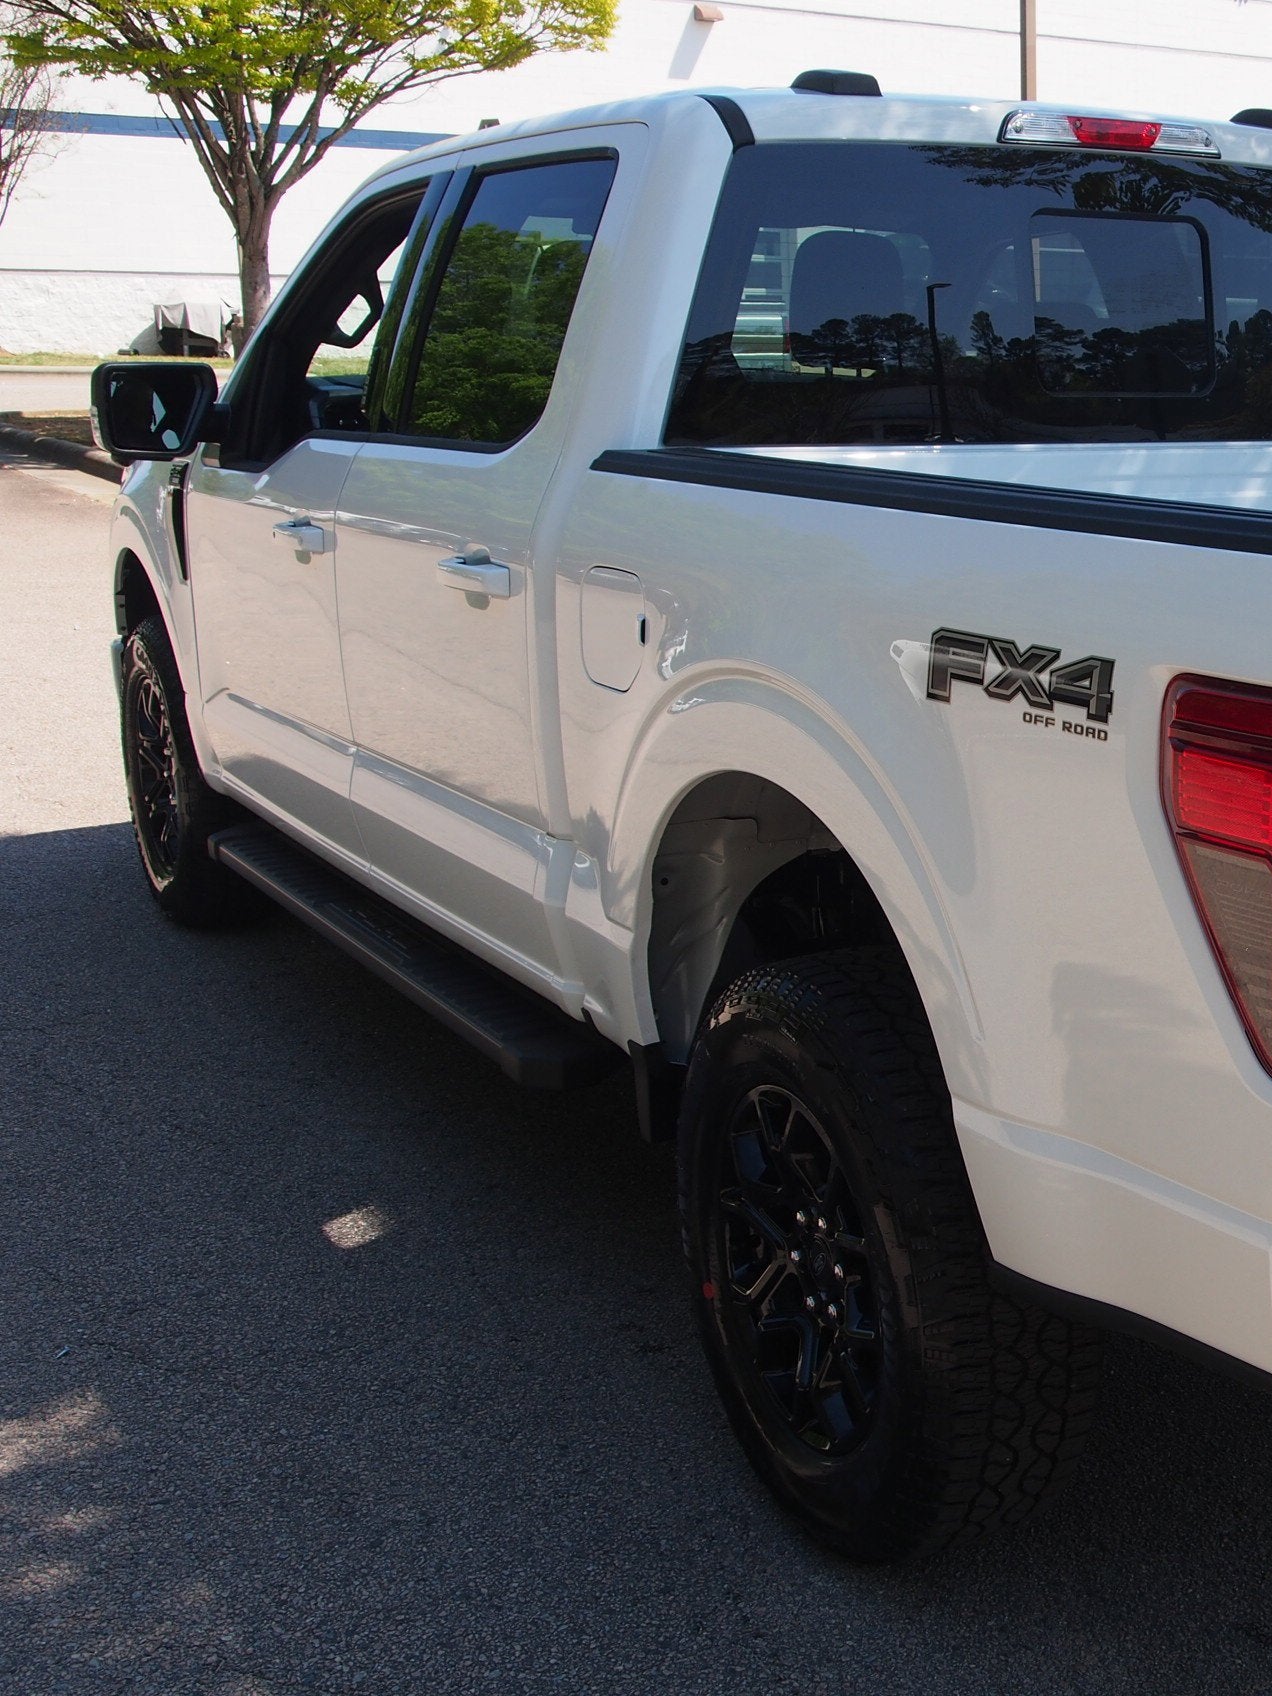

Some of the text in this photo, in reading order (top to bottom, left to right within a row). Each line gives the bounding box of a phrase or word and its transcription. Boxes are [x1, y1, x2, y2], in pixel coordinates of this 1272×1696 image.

[926, 626, 1116, 726] FX4
[1022, 711, 1109, 742] OFF ROAD
